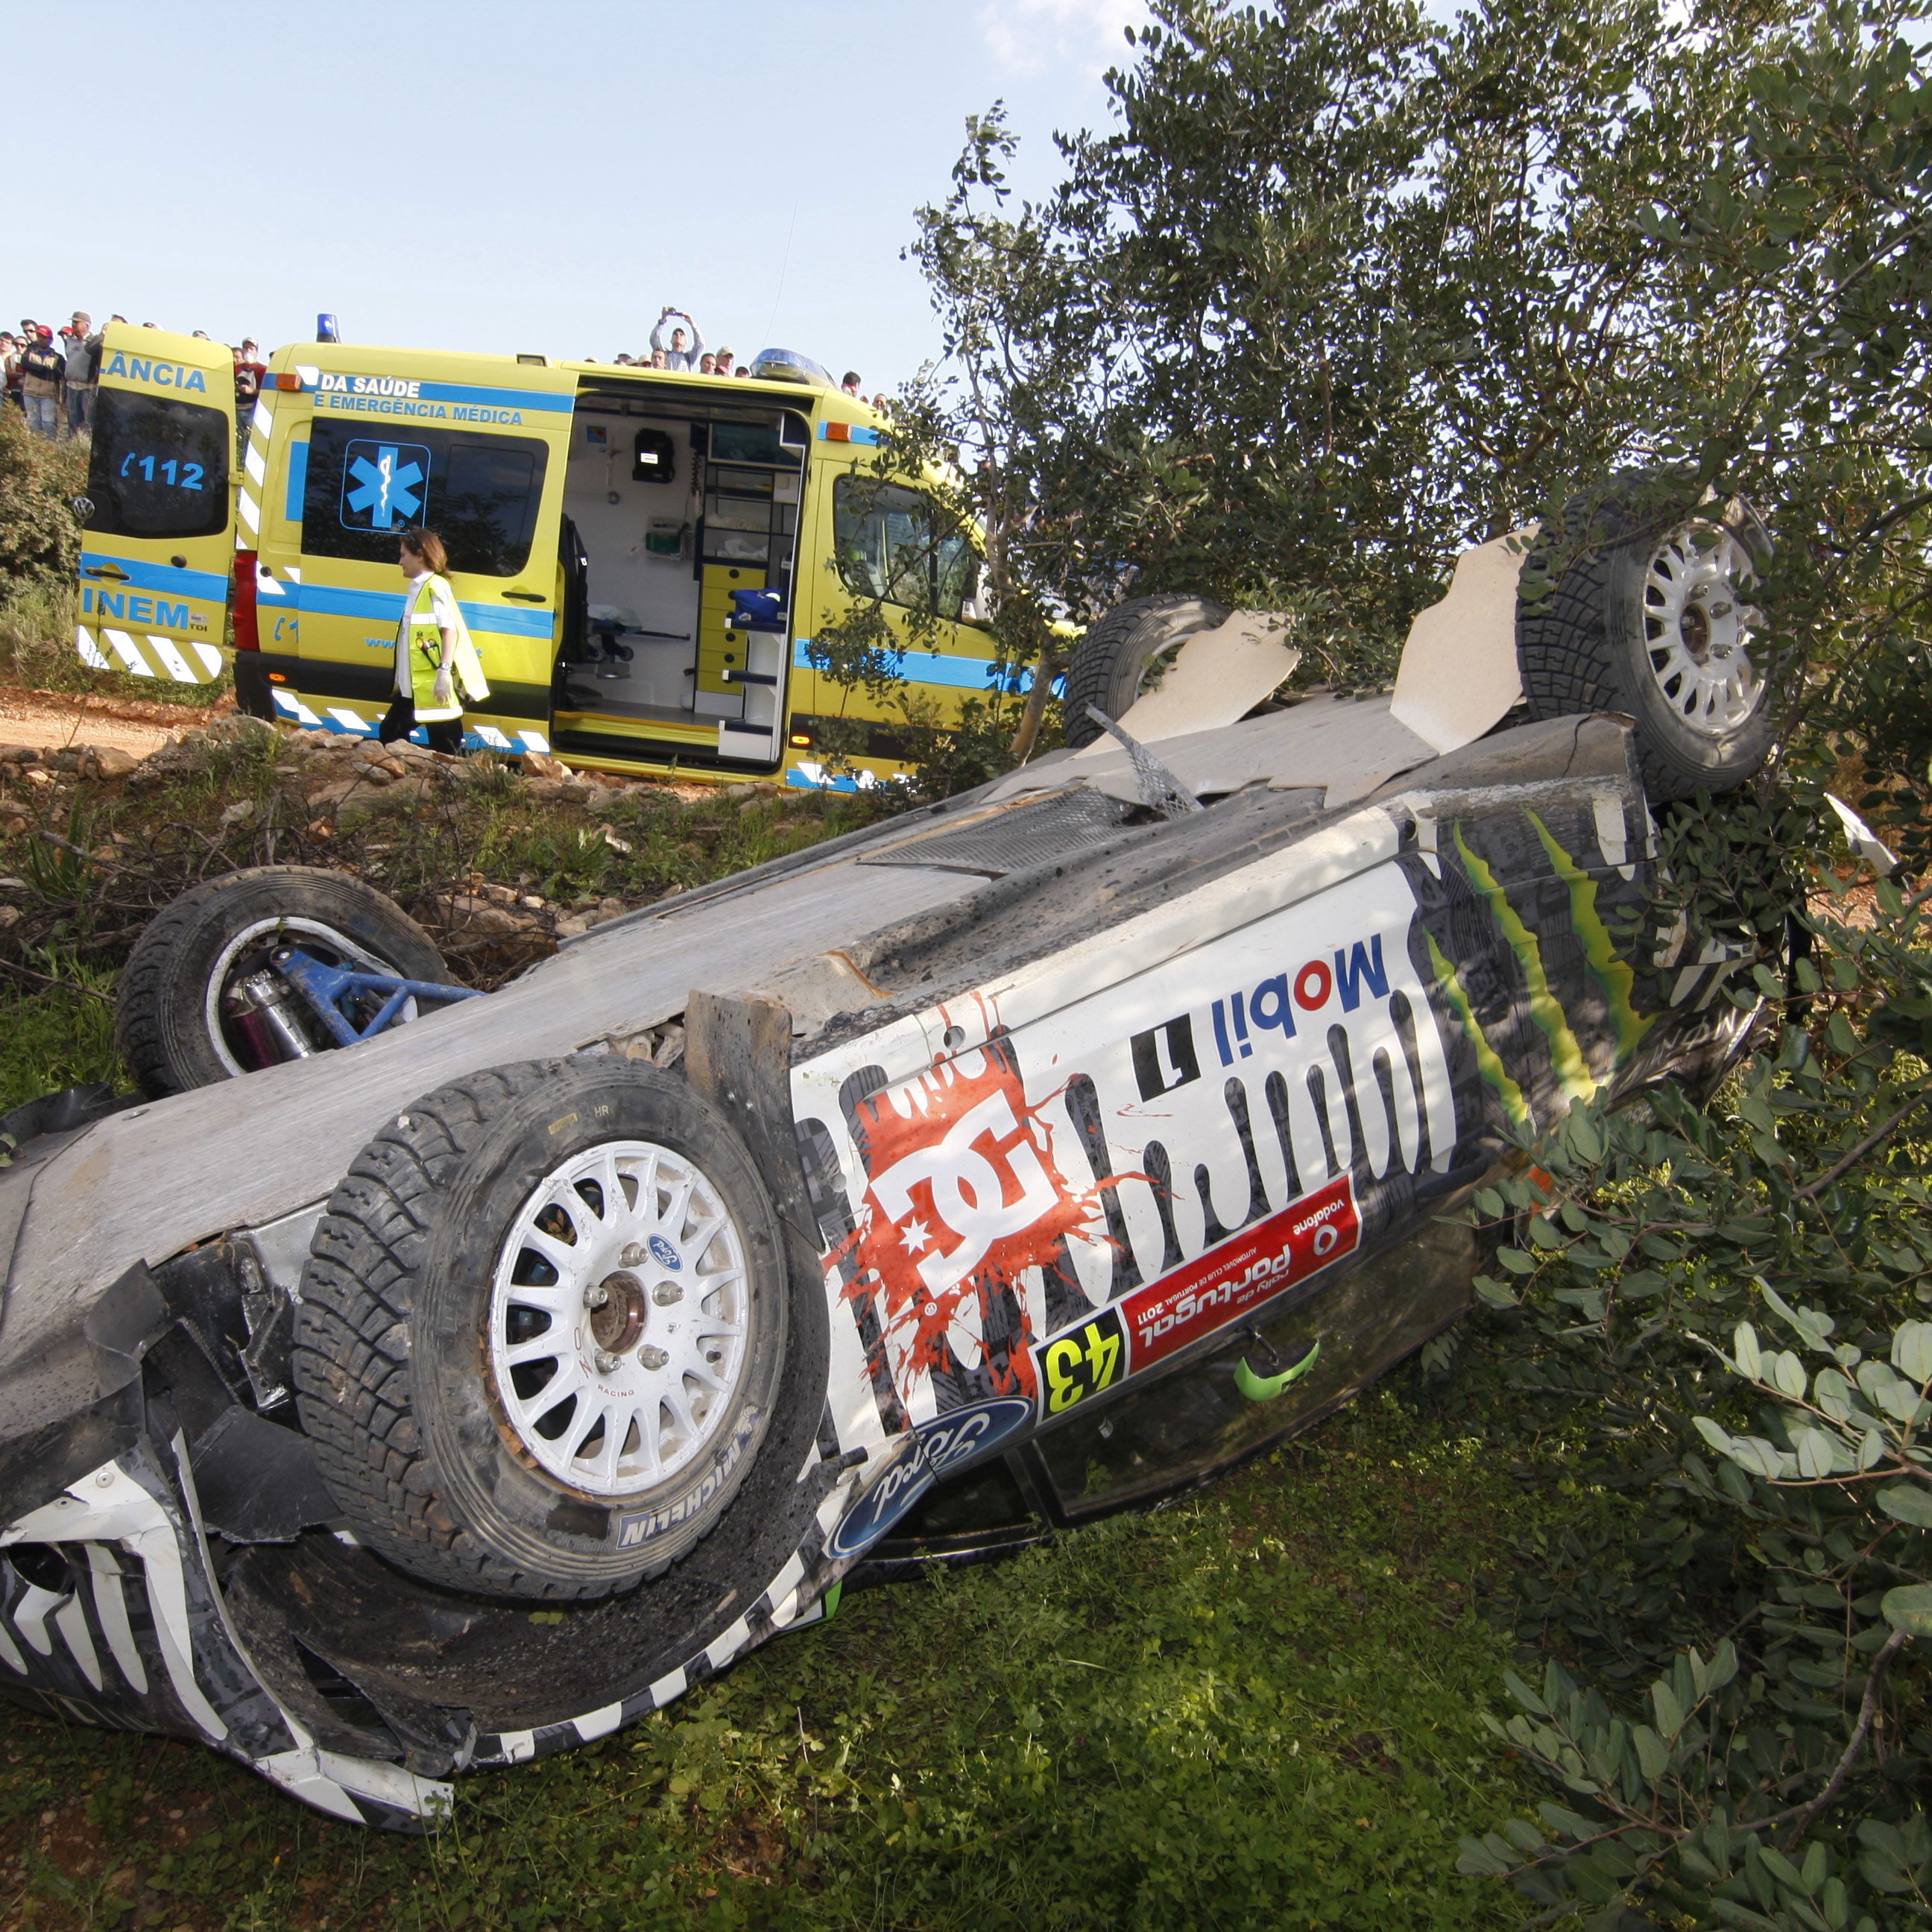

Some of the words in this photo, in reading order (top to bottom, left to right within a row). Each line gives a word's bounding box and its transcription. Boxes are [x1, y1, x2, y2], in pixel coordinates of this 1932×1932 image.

[98, 350, 207, 393] ÂNCIA
[321, 373, 349, 392] DA
[353, 375, 420, 398] SAÚDE
[314, 394, 326, 407] E
[329, 394, 447, 419] EMERGÊNCIA
[452, 405, 523, 425] MÉDICA
[138, 455, 205, 491] 112
[83, 587, 189, 630] INEM
[189, 623, 207, 632] TDI
[1211, 932, 1391, 1067] Mobil
[1154, 1026, 1183, 1090] 1
[594, 1105, 610, 1118] HR
[870, 1088, 1059, 1301] DC
[1292, 1199, 1345, 1236] vodafone
[653, 1240, 678, 1266] Ford
[1198, 1277, 1208, 1287] DE
[1207, 1267, 1223, 1281] CLUB
[1257, 1269, 1289, 1293] rally
[1164, 1282, 1199, 1306] PORTUGAL
[1237, 1288, 1255, 1304] de
[1137, 1301, 1164, 1326] 2011
[1046, 1321, 1120, 1413] 43
[597, 1383, 635, 1398] RACING
[872, 1412, 991, 1525] Ford
[621, 1436, 741, 1548] MICHELIN
